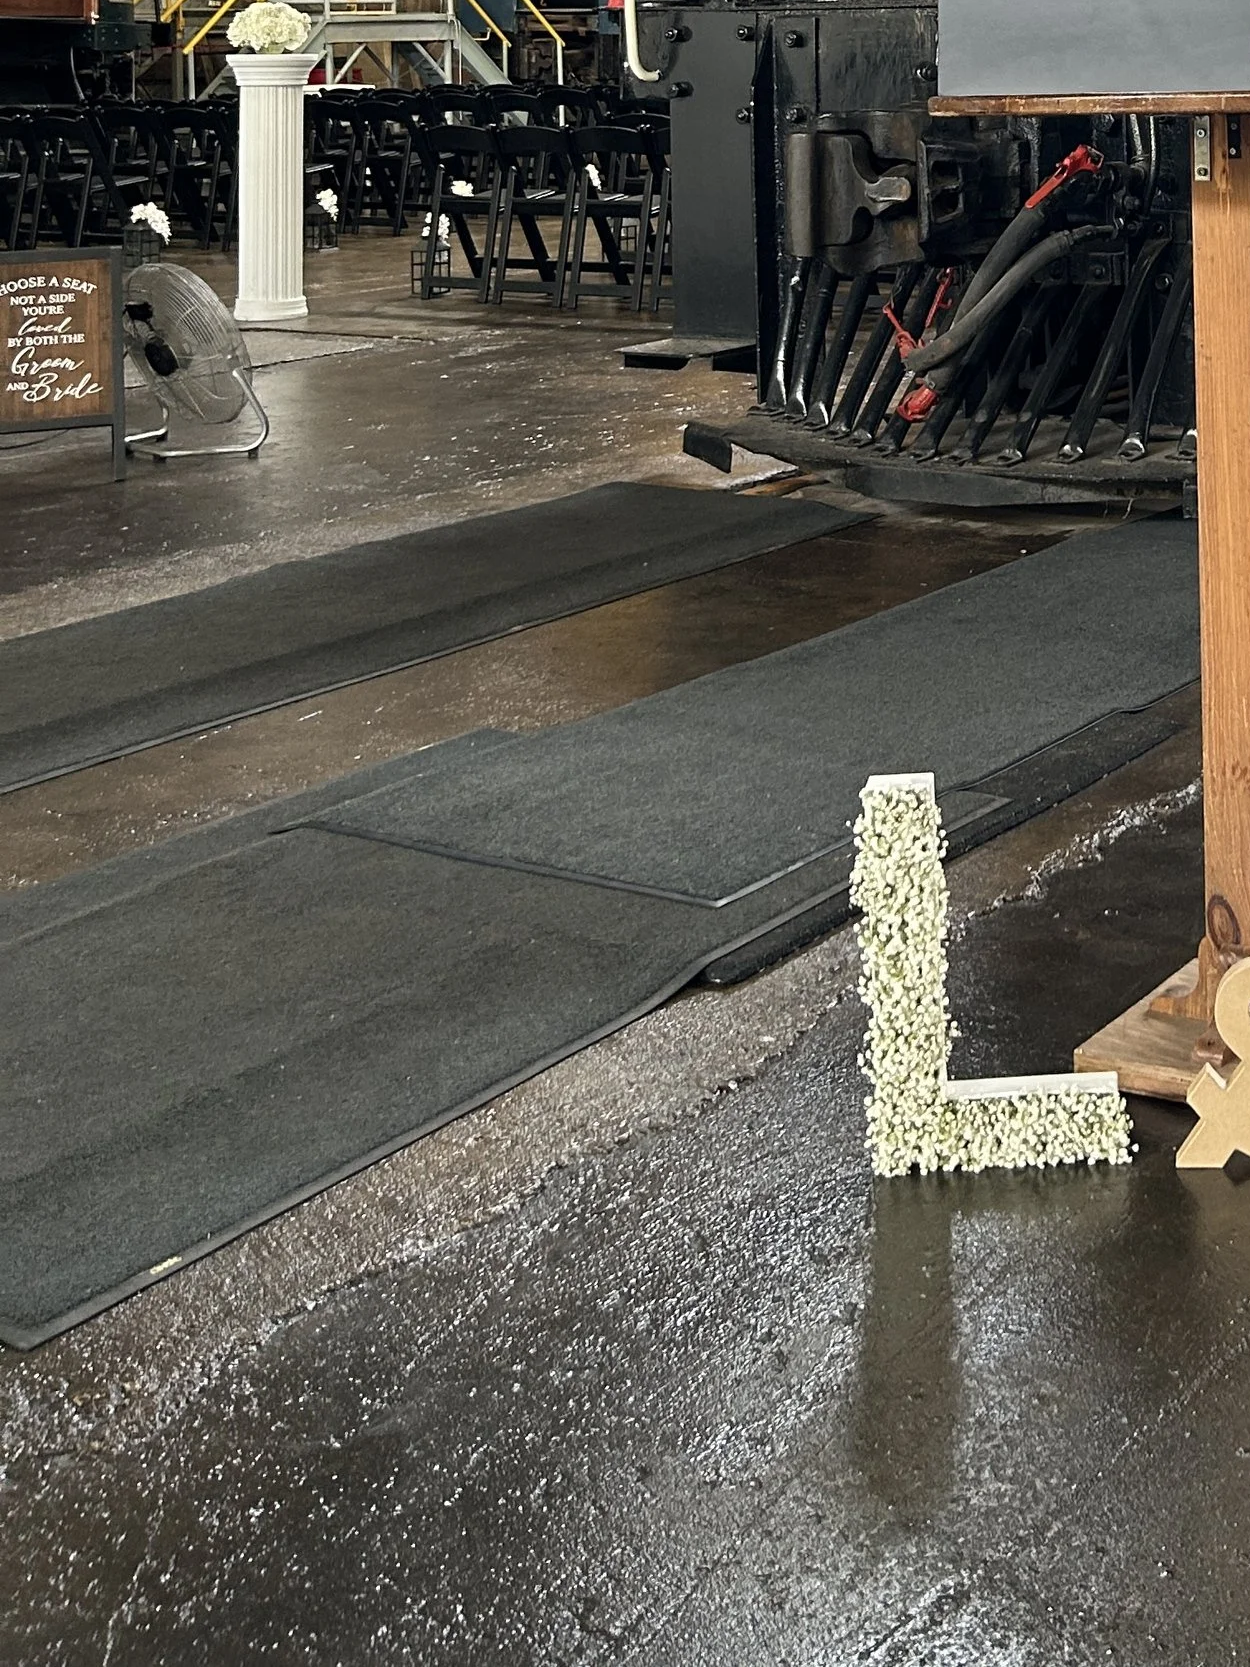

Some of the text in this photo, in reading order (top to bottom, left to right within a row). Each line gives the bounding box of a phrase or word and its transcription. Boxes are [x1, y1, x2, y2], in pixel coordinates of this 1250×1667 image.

[0, 276, 98, 296] HOOSE A SEAT
[10, 293, 75, 306] NOT A SIDE
[22, 305, 64, 316] YOU'RE
[8, 334, 85, 348] BY BOTH THE
[11, 346, 84, 376] Groom
[6, 372, 103, 403] AND Bride
[850, 772, 1132, 1176] L
